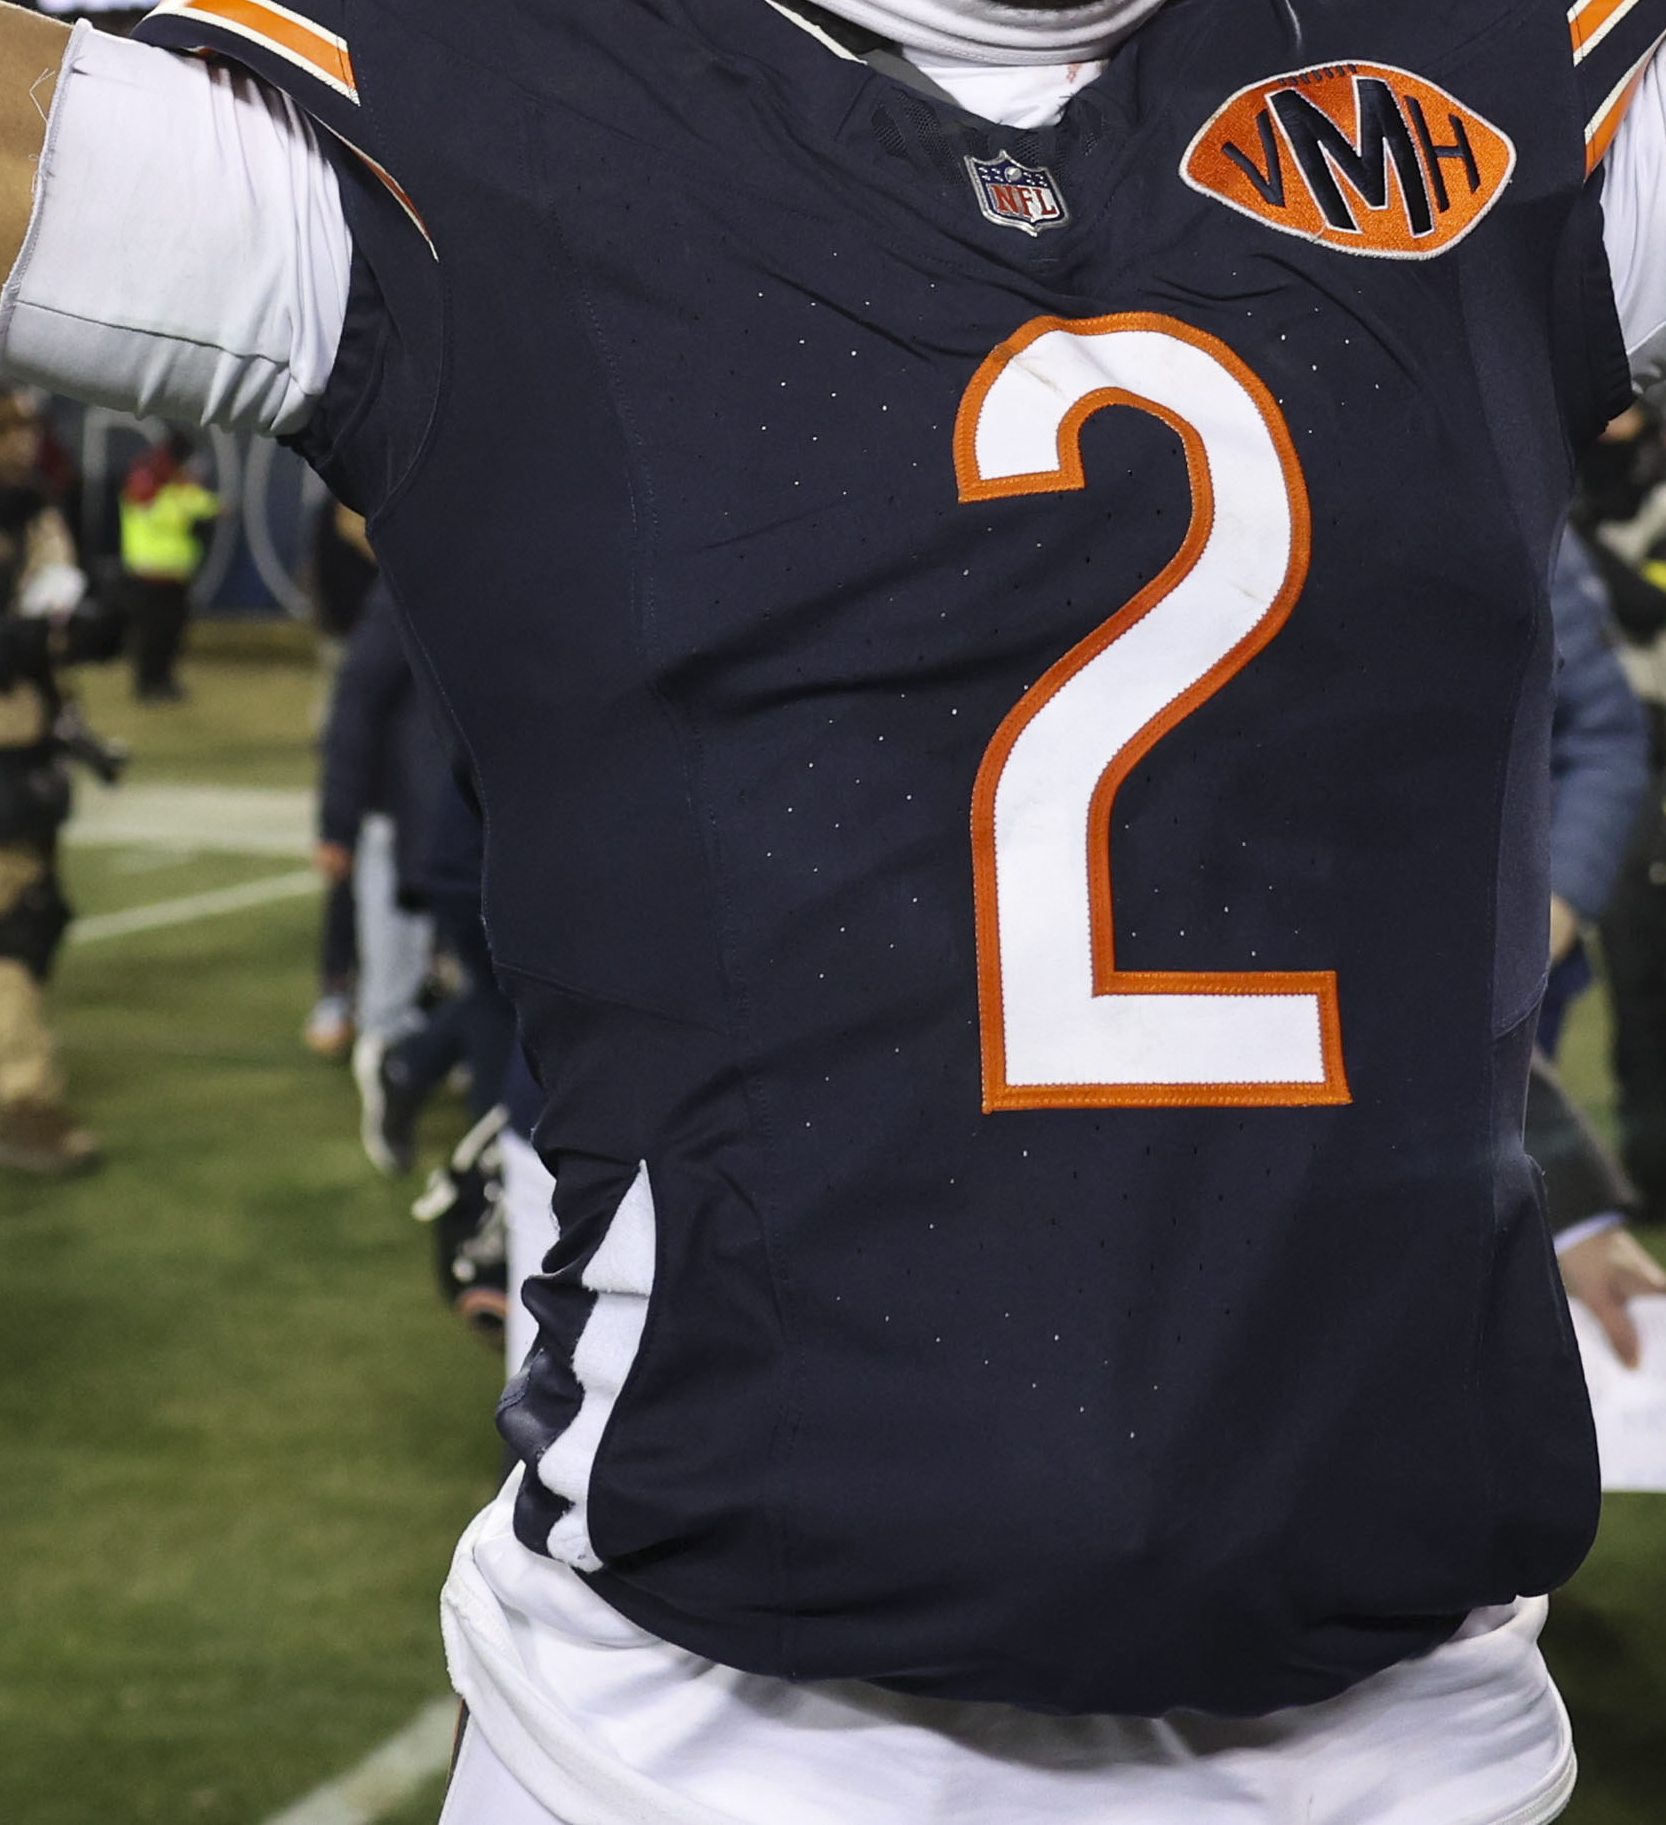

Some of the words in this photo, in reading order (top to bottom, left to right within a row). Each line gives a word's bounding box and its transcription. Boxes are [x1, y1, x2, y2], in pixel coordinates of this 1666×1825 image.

[989, 183, 1059, 220] NFL
[1221, 74, 1481, 239] VMH
[953, 311, 1353, 1114] 2
